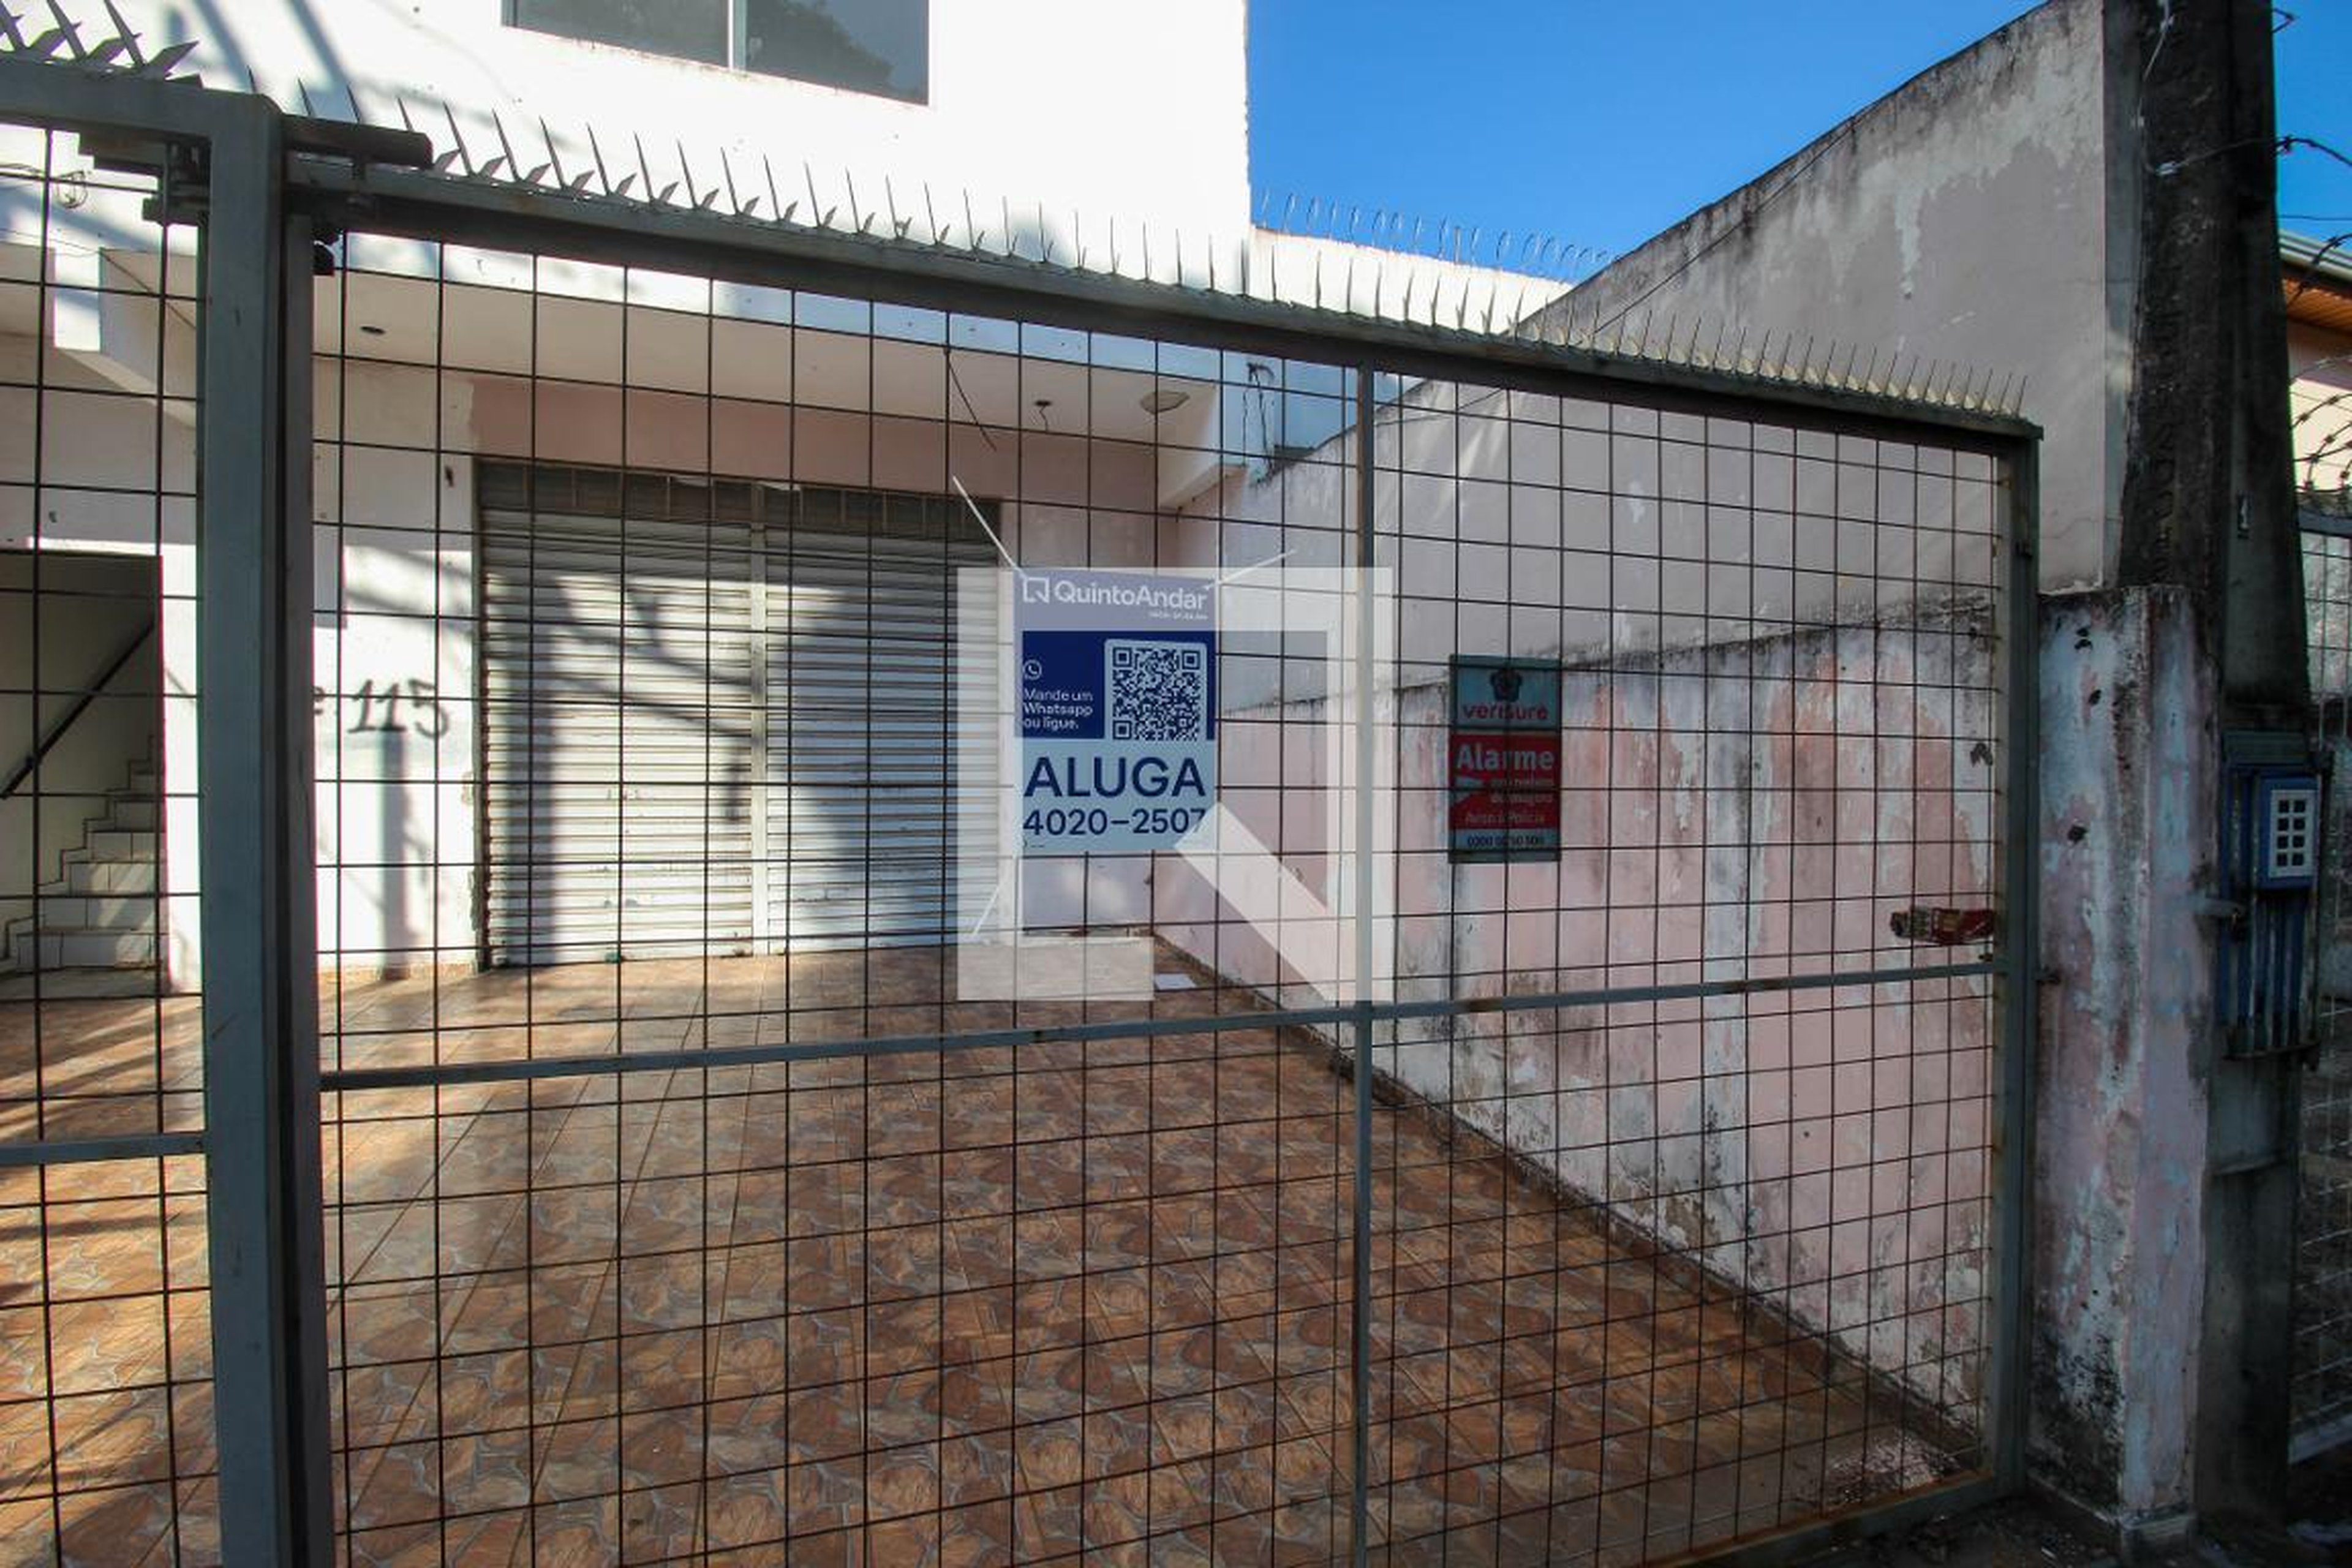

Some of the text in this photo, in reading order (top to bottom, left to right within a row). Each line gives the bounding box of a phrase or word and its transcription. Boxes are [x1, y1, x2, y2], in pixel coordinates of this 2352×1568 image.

[1054, 579, 1208, 610] QuintoAndar
[1071, 692, 1094, 701] um
[347, 679, 449, 739] 115
[1023, 702, 1094, 718] Whatsapp
[1023, 718, 1041, 729] ou
[1023, 756, 1207, 797] ALUGA
